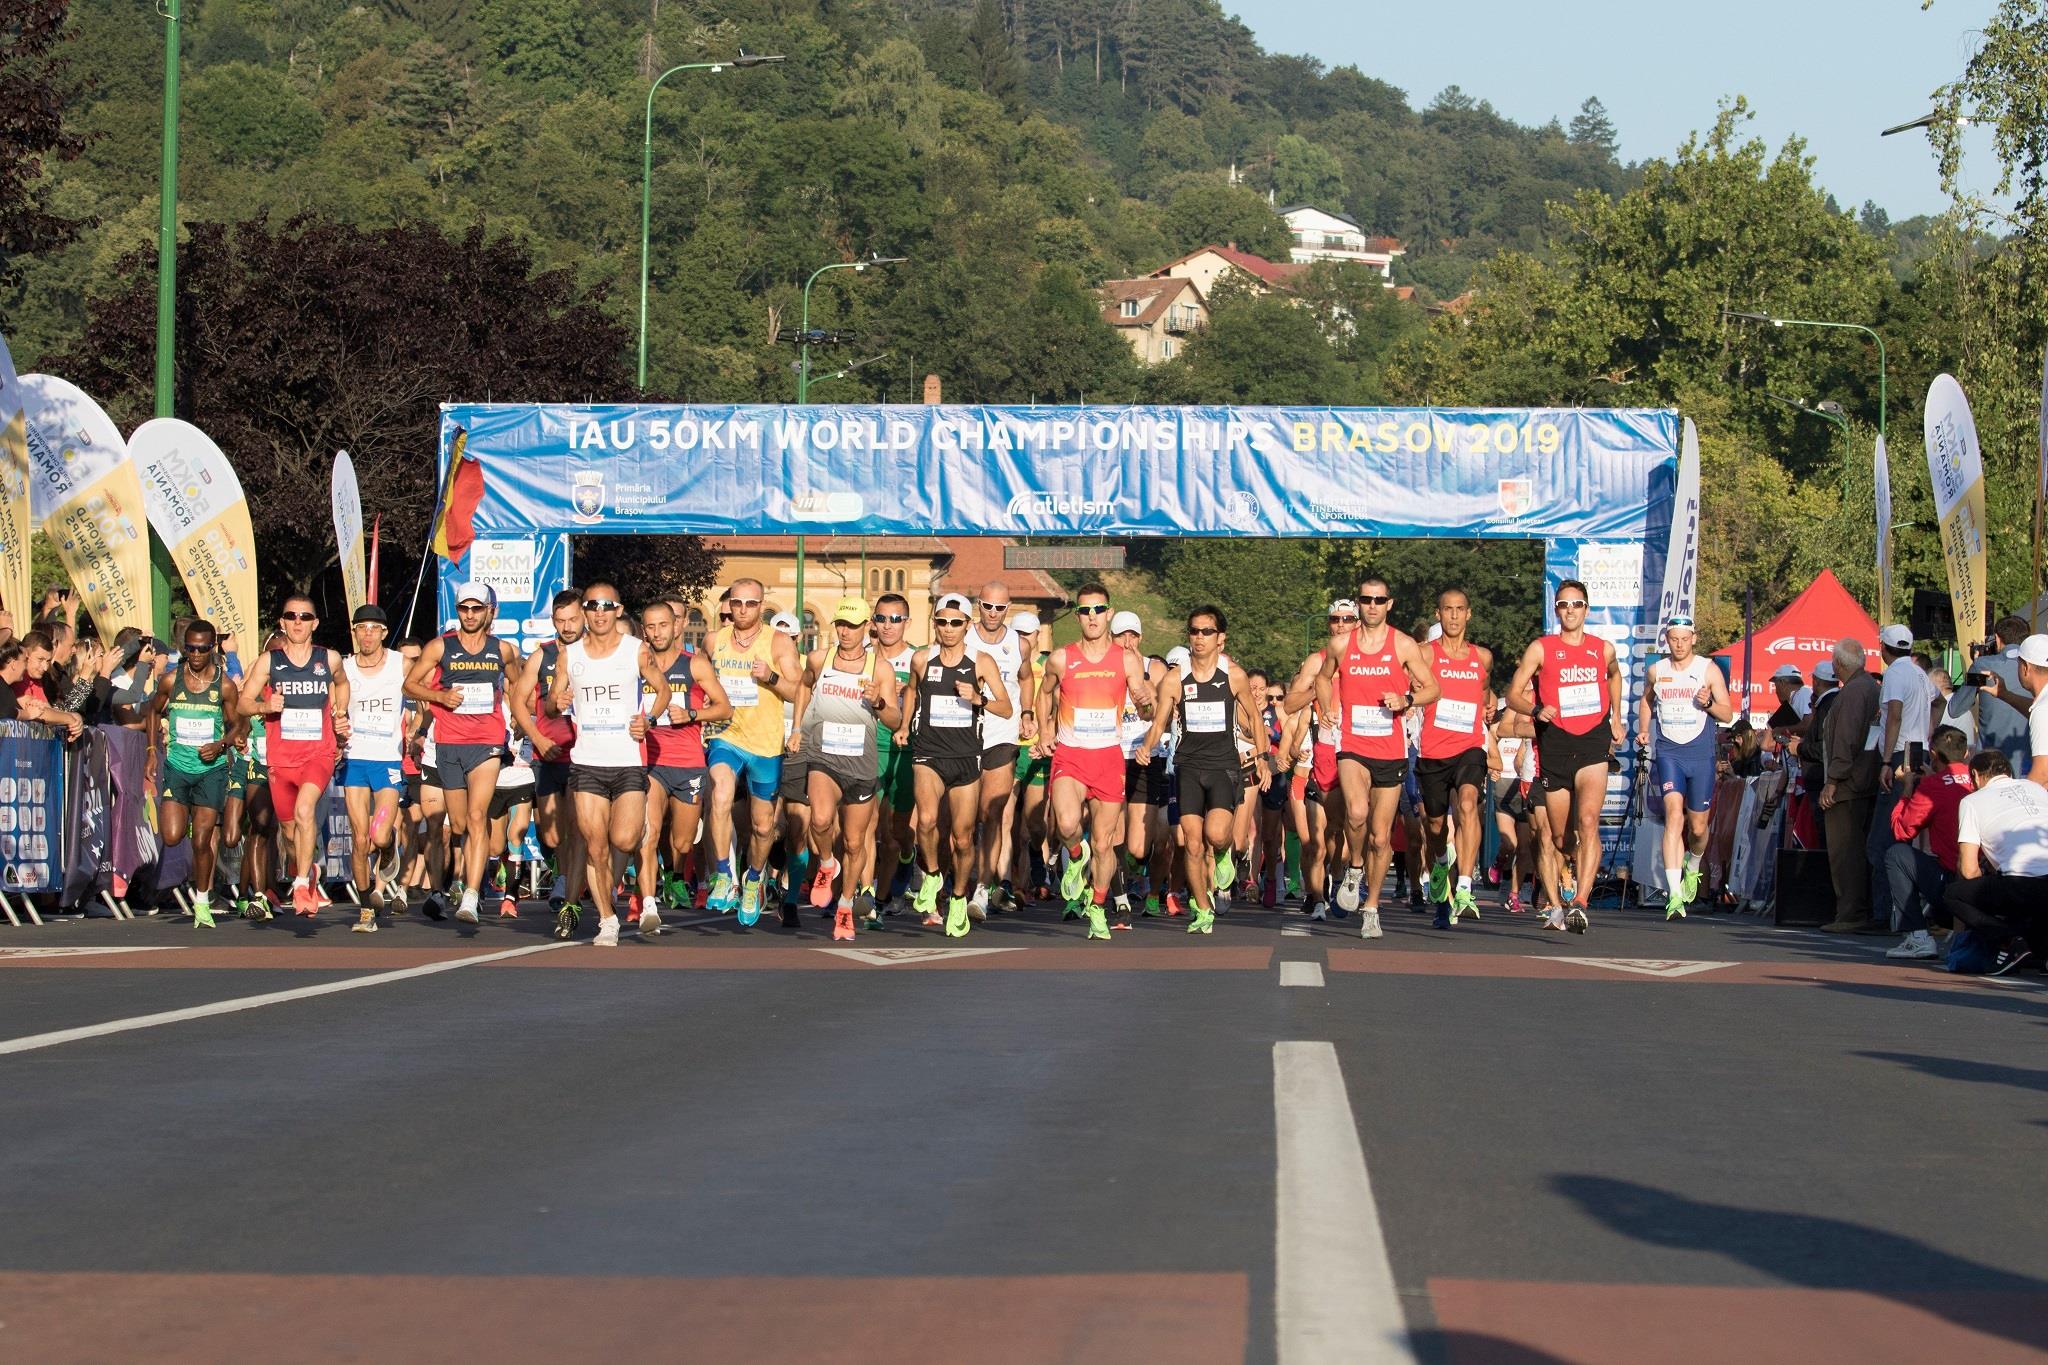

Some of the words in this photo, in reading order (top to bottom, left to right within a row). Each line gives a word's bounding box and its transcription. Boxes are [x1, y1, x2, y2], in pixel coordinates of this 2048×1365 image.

[569, 420, 636, 450] IAU
[648, 420, 759, 450] 50KM
[772, 420, 917, 450] WORLD
[930, 420, 1275, 451] CHAMPIONSHIPS
[1292, 421, 1457, 453] BRASOV
[1467, 423, 1560, 454] 2019
[615, 495, 667, 505] Municipiului
[475, 555, 531, 571] 50KM
[450, 661, 499, 671] ROMANIA
[720, 659, 752, 671] UKRAIN
[1350, 666, 1391, 676] CANADA
[1440, 669, 1479, 681] CANADA
[1559, 664, 1598, 683] suisse
[581, 684, 622, 702] TPE
[1661, 687, 1696, 701] NORWAY
[358, 697, 393, 713] TPE
[594, 707, 610, 715] 178
